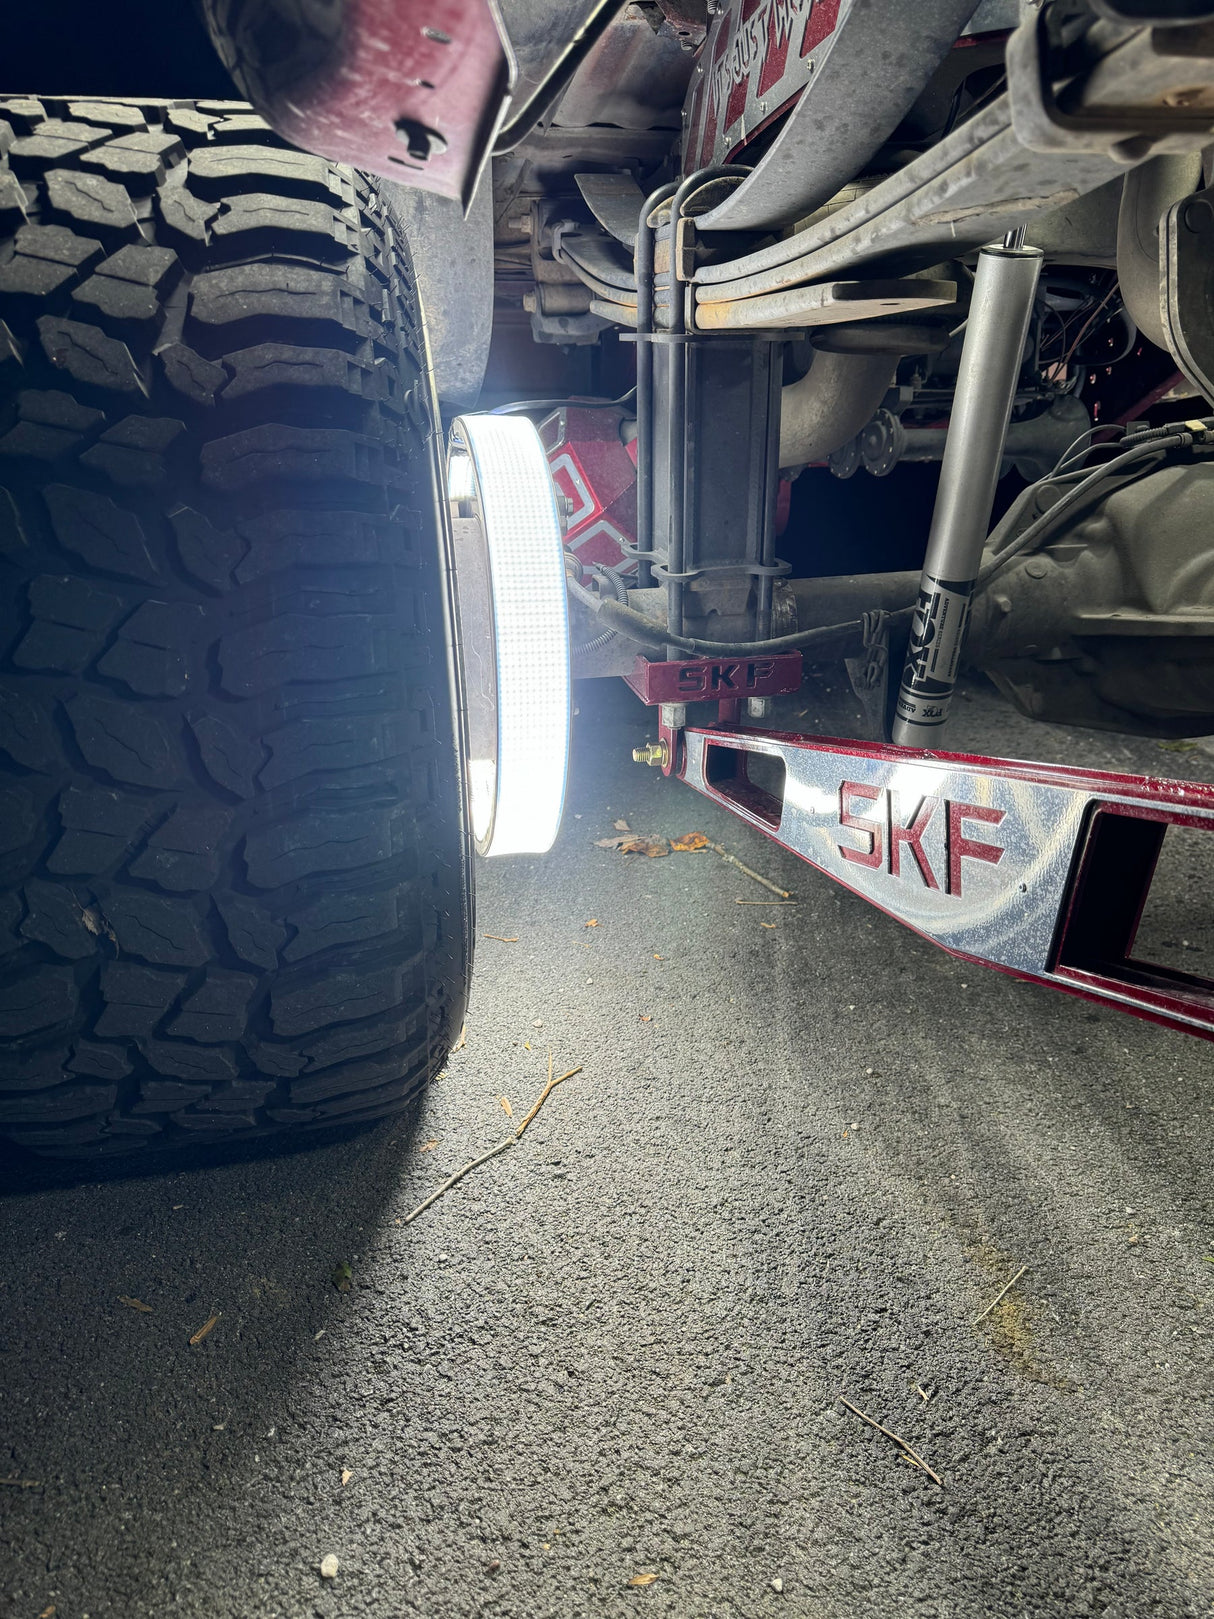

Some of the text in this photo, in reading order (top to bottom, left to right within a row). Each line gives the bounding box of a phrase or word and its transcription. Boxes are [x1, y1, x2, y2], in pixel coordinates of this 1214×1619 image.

[903, 589, 941, 683] FOX
[938, 597, 950, 631] ADVENTURE
[678, 661, 775, 692] SKF
[838, 780, 1008, 899] SKF
